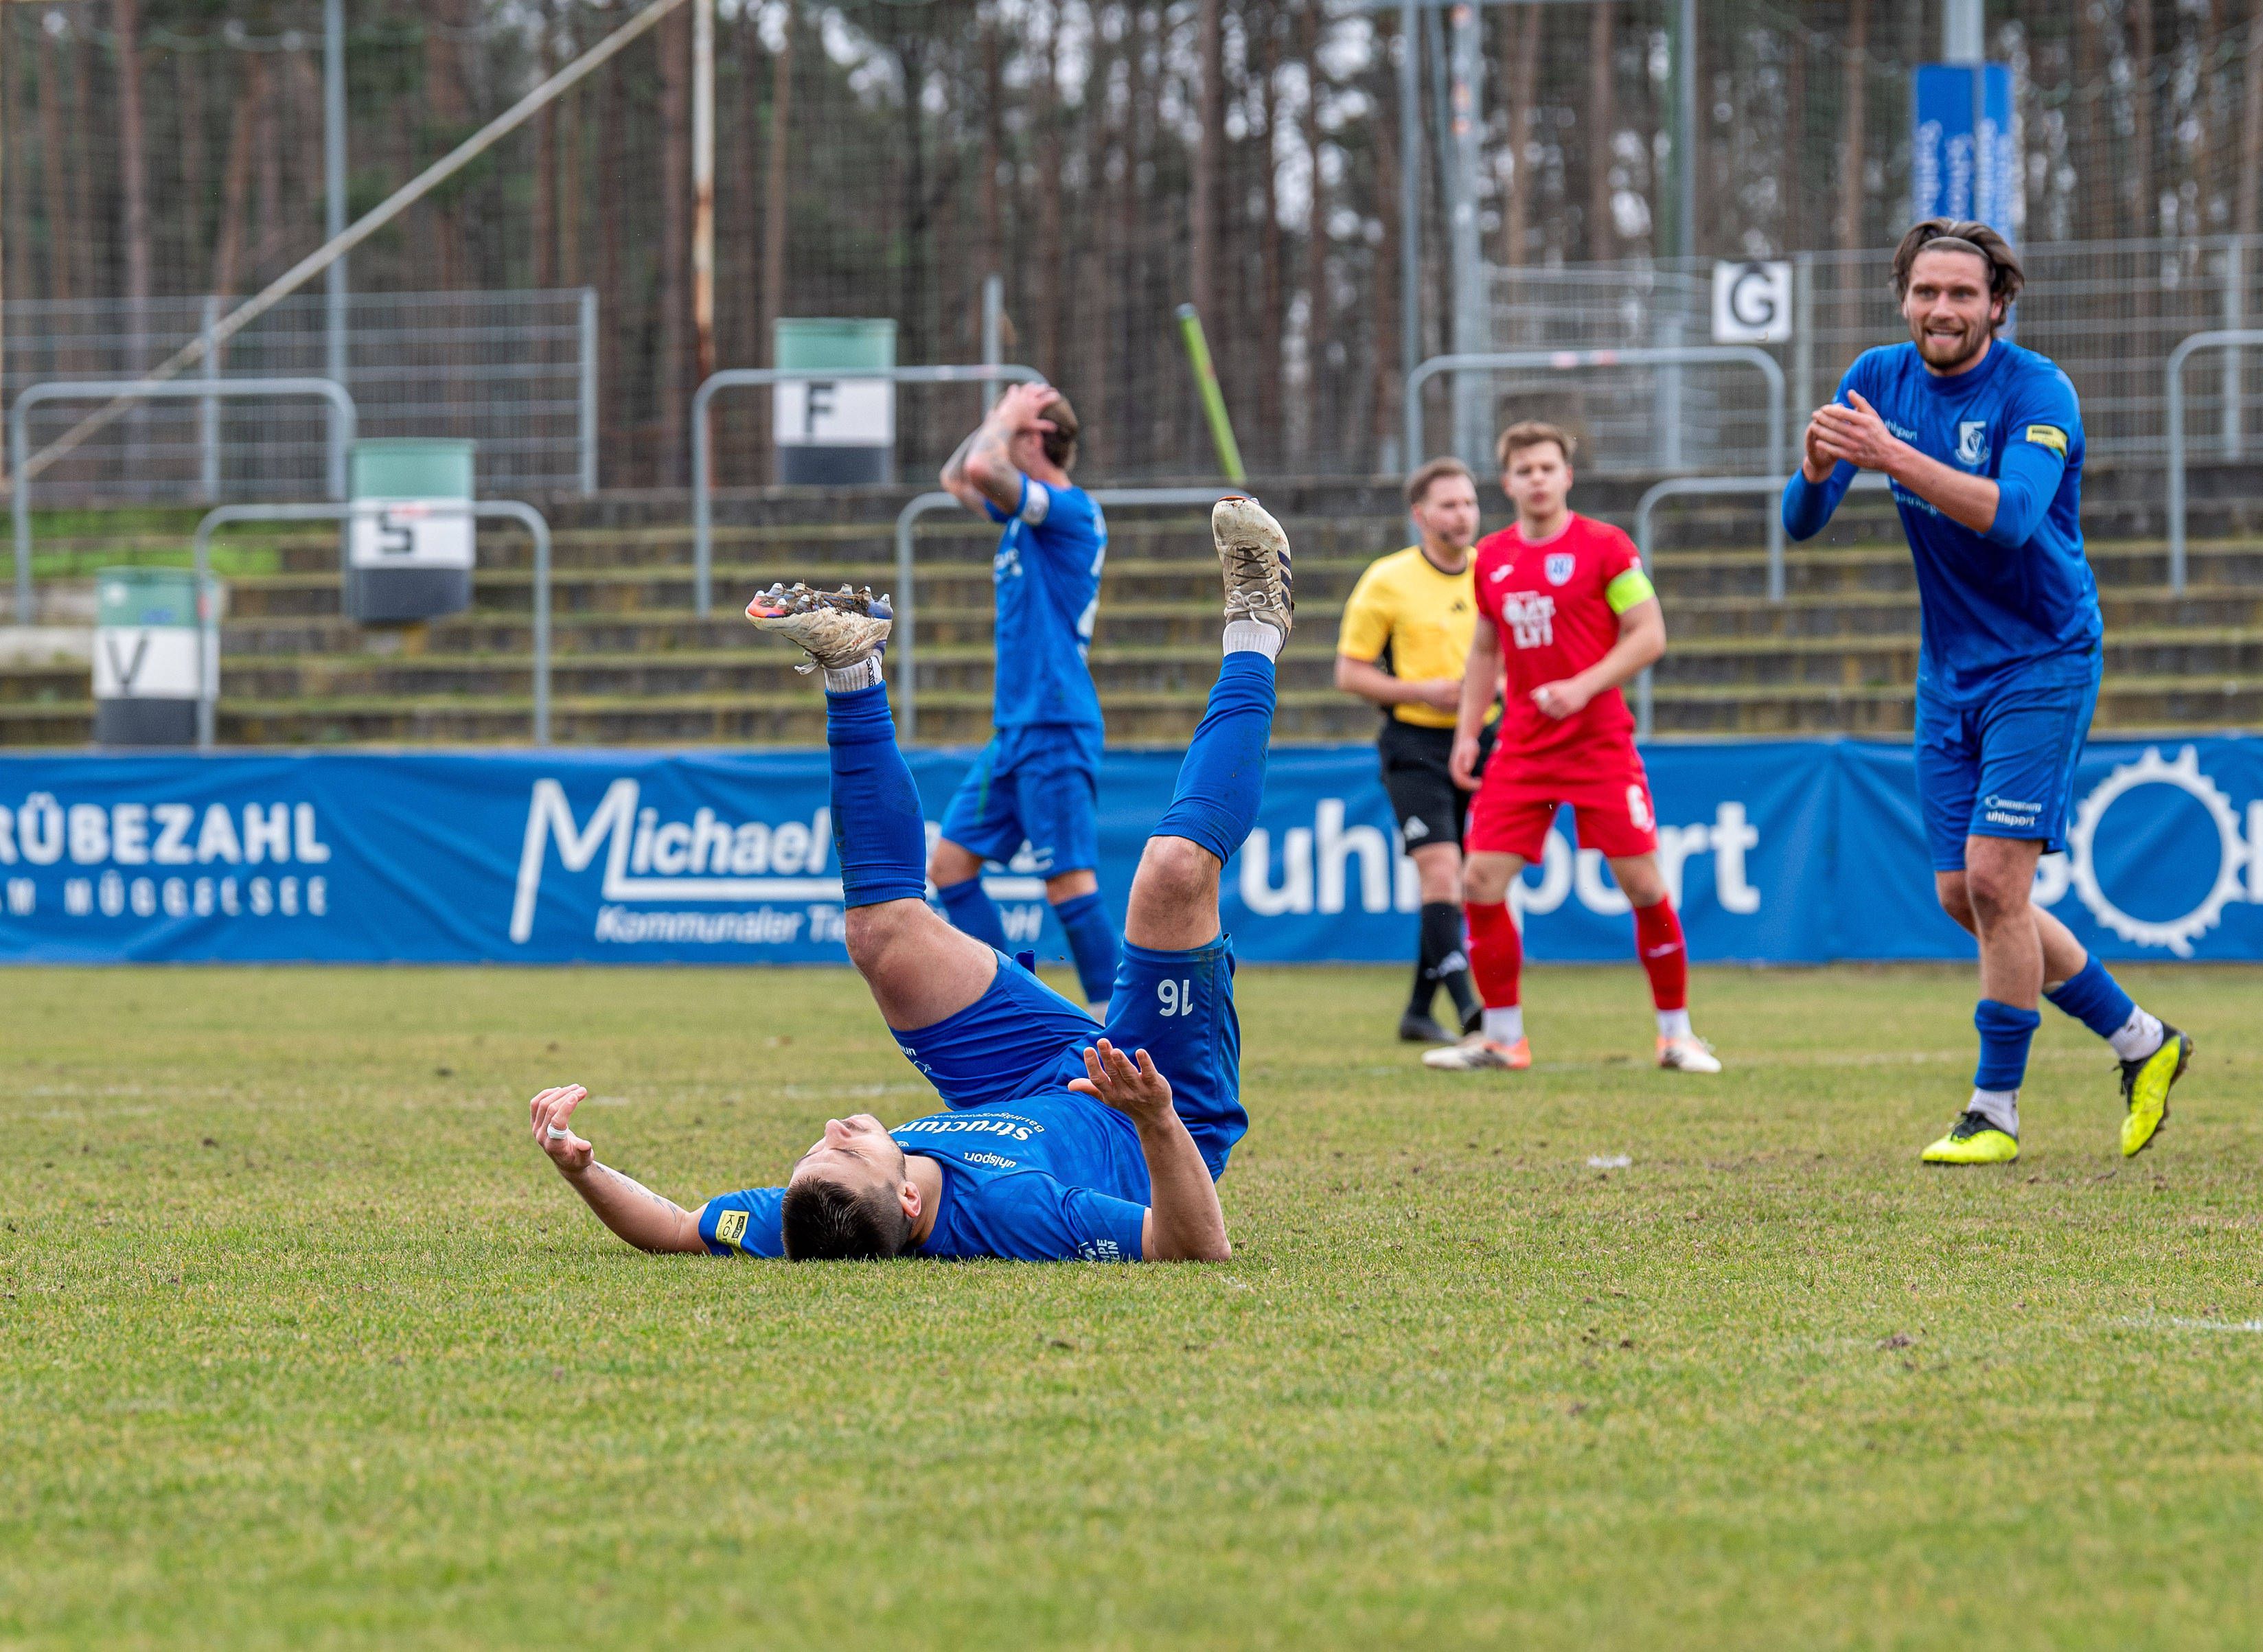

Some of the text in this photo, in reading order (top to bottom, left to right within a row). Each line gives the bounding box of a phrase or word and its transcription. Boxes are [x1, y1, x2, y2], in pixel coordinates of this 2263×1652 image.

[1729, 260, 1776, 328] G
[804, 380, 836, 438] F
[106, 633, 149, 692] V
[1626, 785, 1648, 829] 6
[1986, 810, 2035, 827] uhlsport
[509, 777, 829, 944] Michael
[1240, 798, 1760, 934] uhlport
[595, 904, 804, 943] Kommunaler
[1158, 979, 1193, 1016] 16
[964, 1151, 1018, 1169] uhlsport
